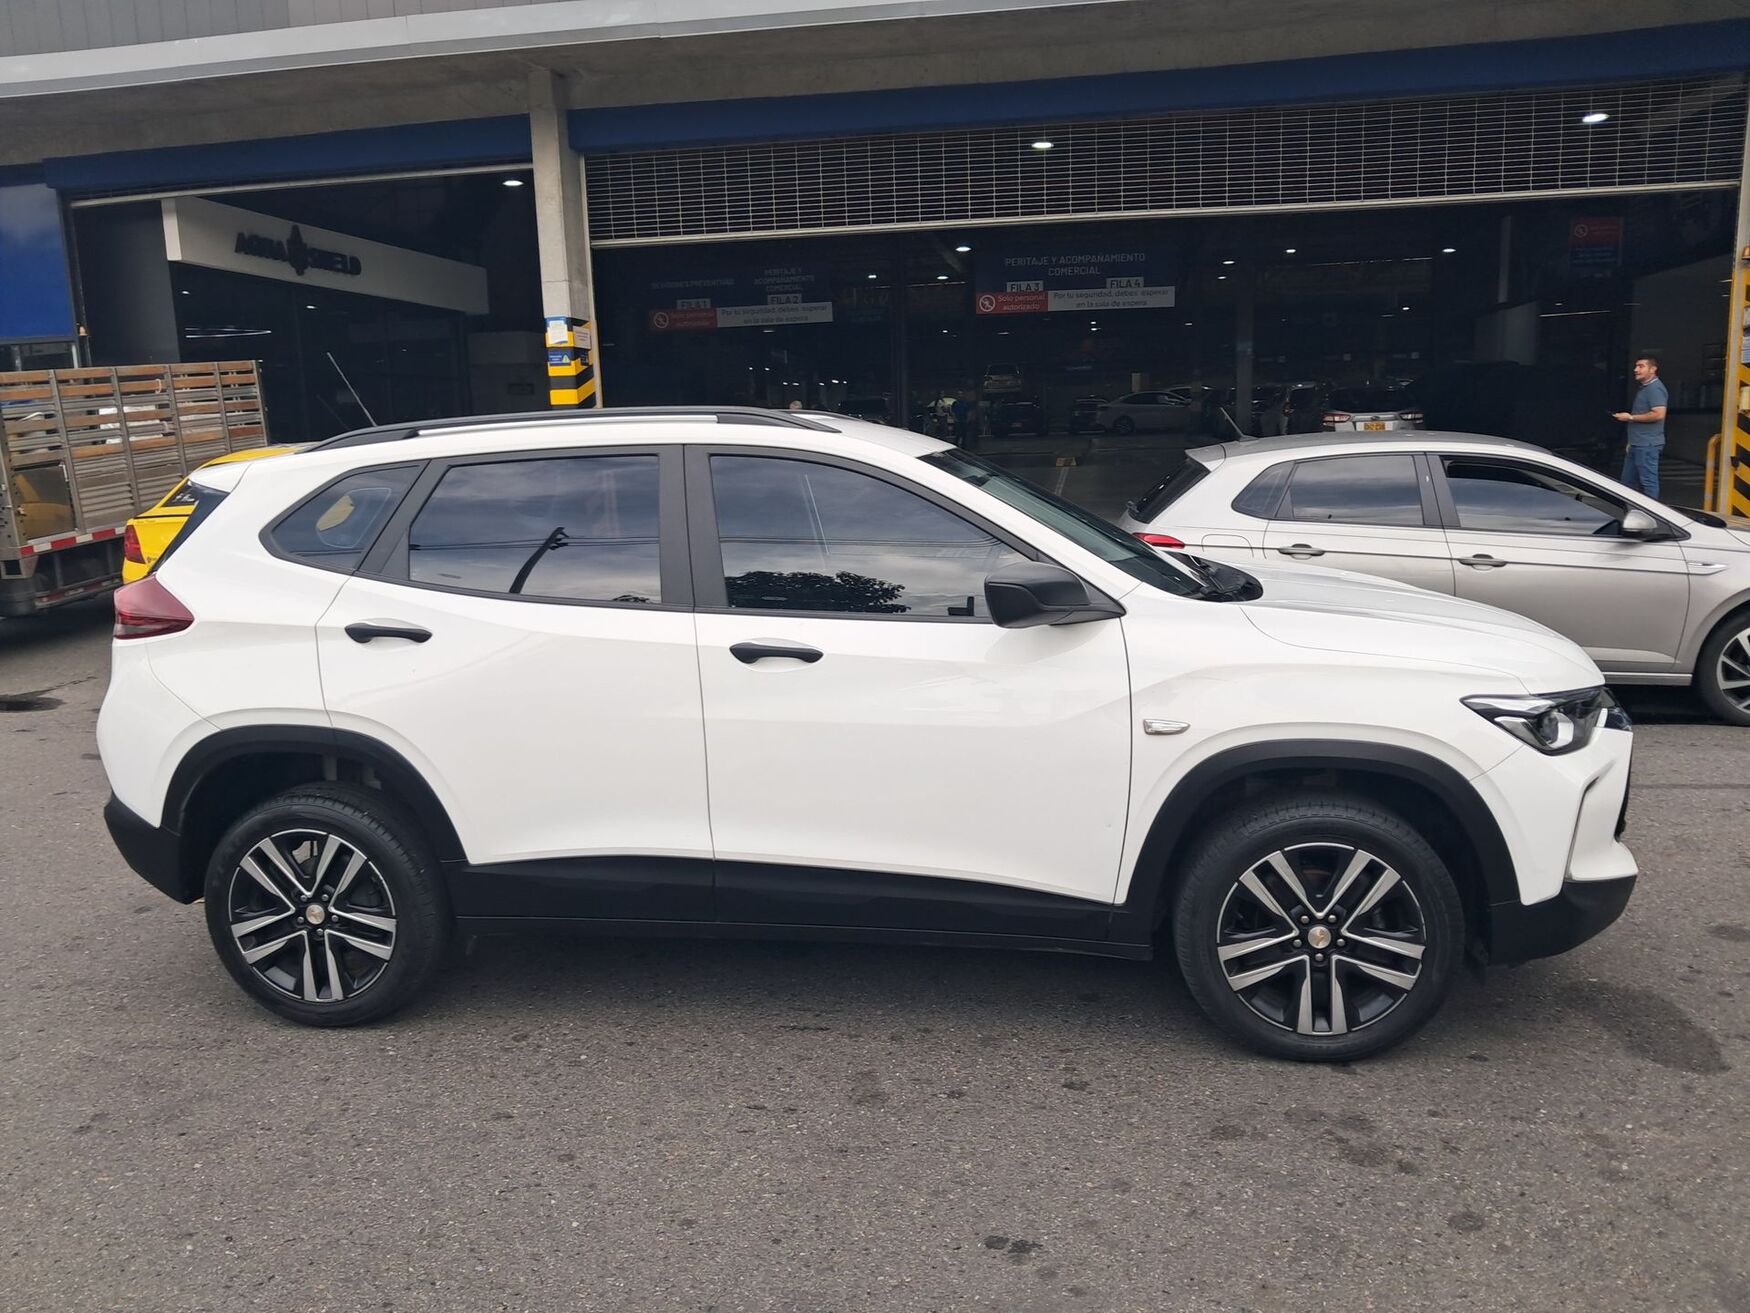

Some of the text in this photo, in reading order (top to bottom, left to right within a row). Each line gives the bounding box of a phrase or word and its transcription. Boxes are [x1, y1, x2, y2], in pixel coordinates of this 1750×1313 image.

[1005, 256, 1049, 267] PERITAJE
[1051, 256, 1057, 264] Y
[1048, 266, 1102, 277] COMERCIAL
[1010, 282, 1040, 292] FILA 3
[1110, 278, 1142, 289] FILA 4
[770, 295, 799, 304] FILA 2
[1015, 293, 1045, 302] personal
[1003, 303, 1040, 311] autorizado
